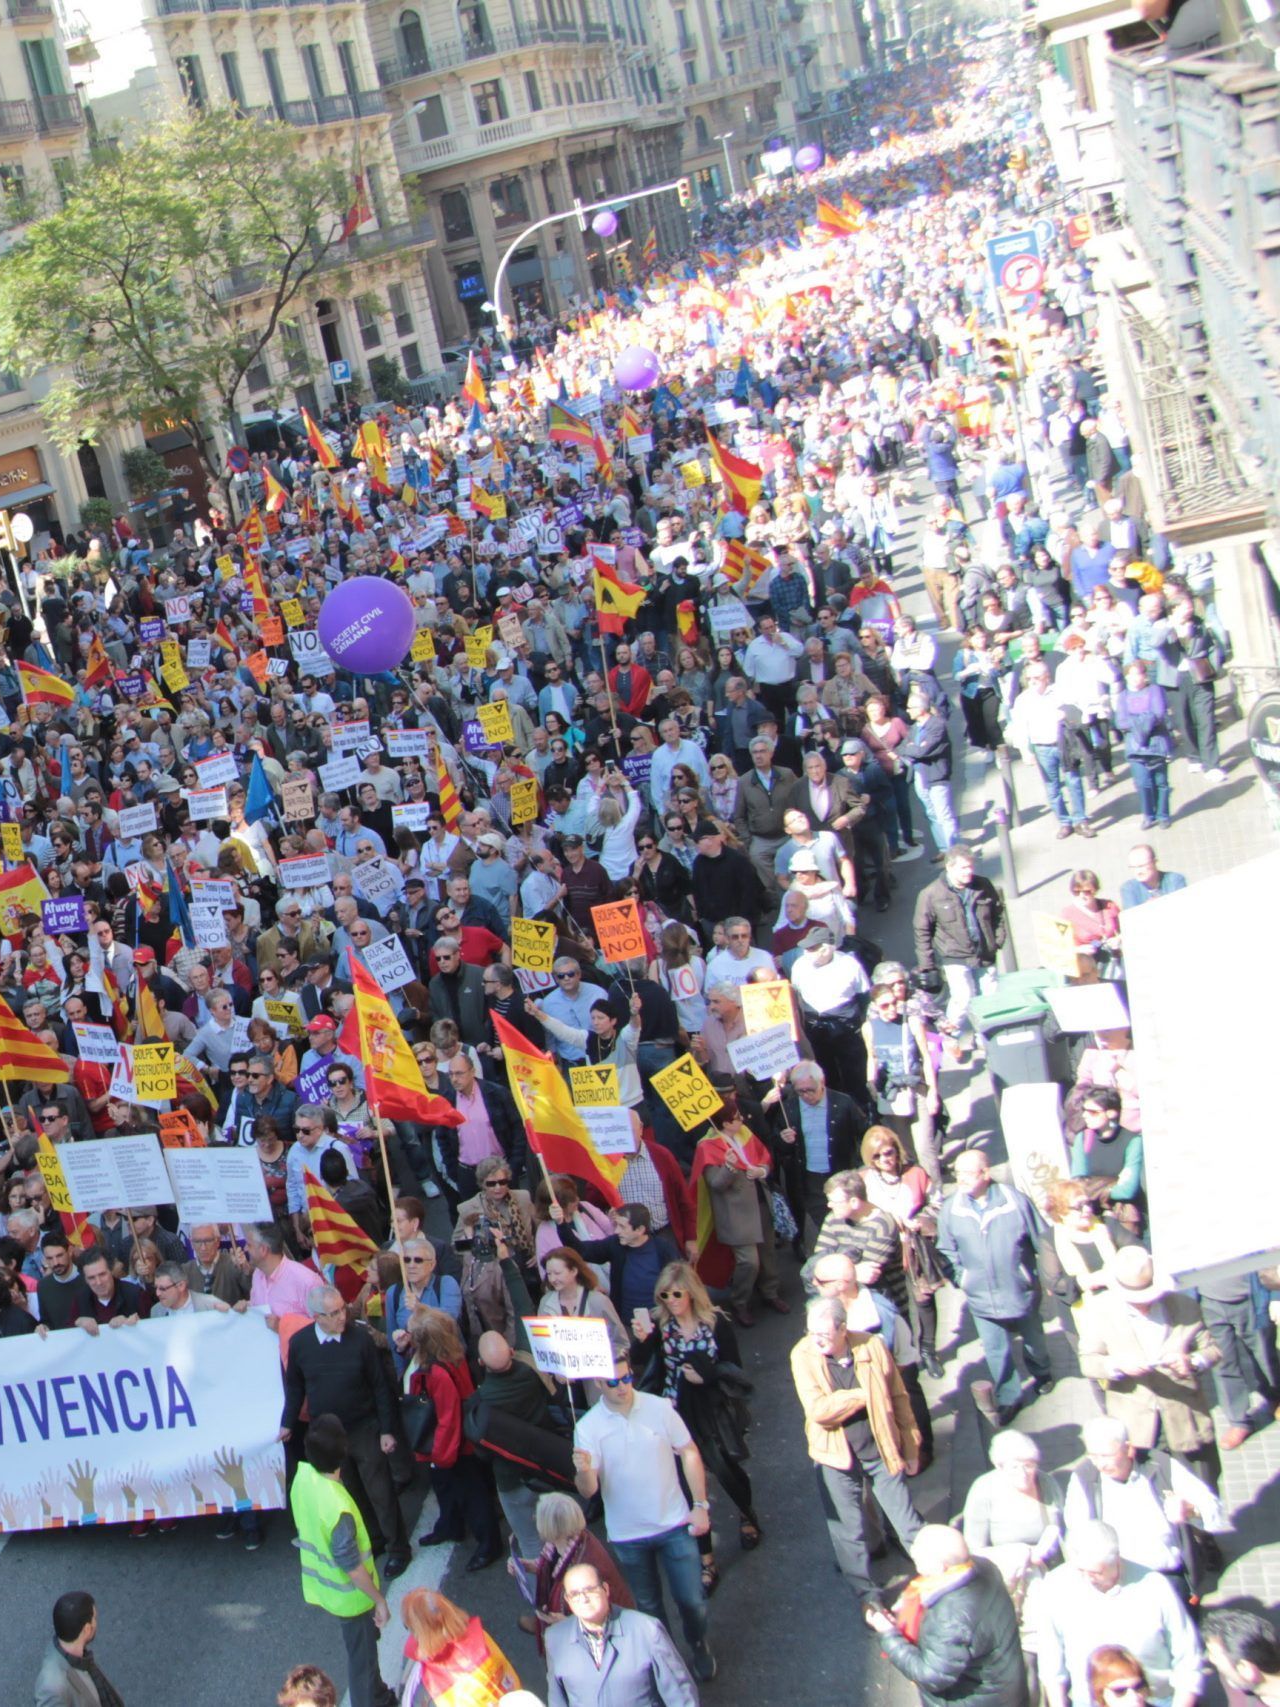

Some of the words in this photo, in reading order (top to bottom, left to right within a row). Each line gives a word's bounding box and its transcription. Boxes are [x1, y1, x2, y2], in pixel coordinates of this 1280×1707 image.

[334, 364, 345, 378] P
[517, 515, 542, 535] NO
[448, 536, 464, 548] NO
[538, 528, 559, 544] NO
[480, 543, 498, 554] NO
[514, 586, 533, 601] NO
[167, 599, 190, 615] NO
[329, 614, 360, 649] SOCIETAT
[360, 607, 383, 625] CIVIL
[291, 633, 317, 651] NO
[335, 625, 372, 655] CATALANA
[270, 661, 285, 674] NO
[359, 736, 381, 758] NO
[623, 753, 652, 770] Ature
[285, 806, 314, 820] NO!
[512, 805, 538, 821] NO!
[44, 901, 79, 915] Aturem
[595, 908, 618, 923] GOLPE
[47, 915, 56, 927] el
[56, 912, 79, 926] cop!
[513, 921, 533, 931] COP
[365, 943, 383, 960] GOLPE
[604, 936, 644, 960] ¡NO!
[513, 950, 551, 968] NO!
[520, 969, 552, 991] NO
[671, 968, 696, 998] NO
[134, 1047, 154, 1060] GOLPE
[300, 1065, 329, 1089] Ature
[571, 1070, 594, 1085] GOLPE
[656, 1075, 678, 1093] GOLPE
[112, 1082, 133, 1097] COP
[136, 1078, 174, 1096] ¡NO!
[667, 1079, 709, 1110] BAJO,
[678, 1090, 720, 1125] ¡NO!
[39, 1155, 58, 1169] COP
